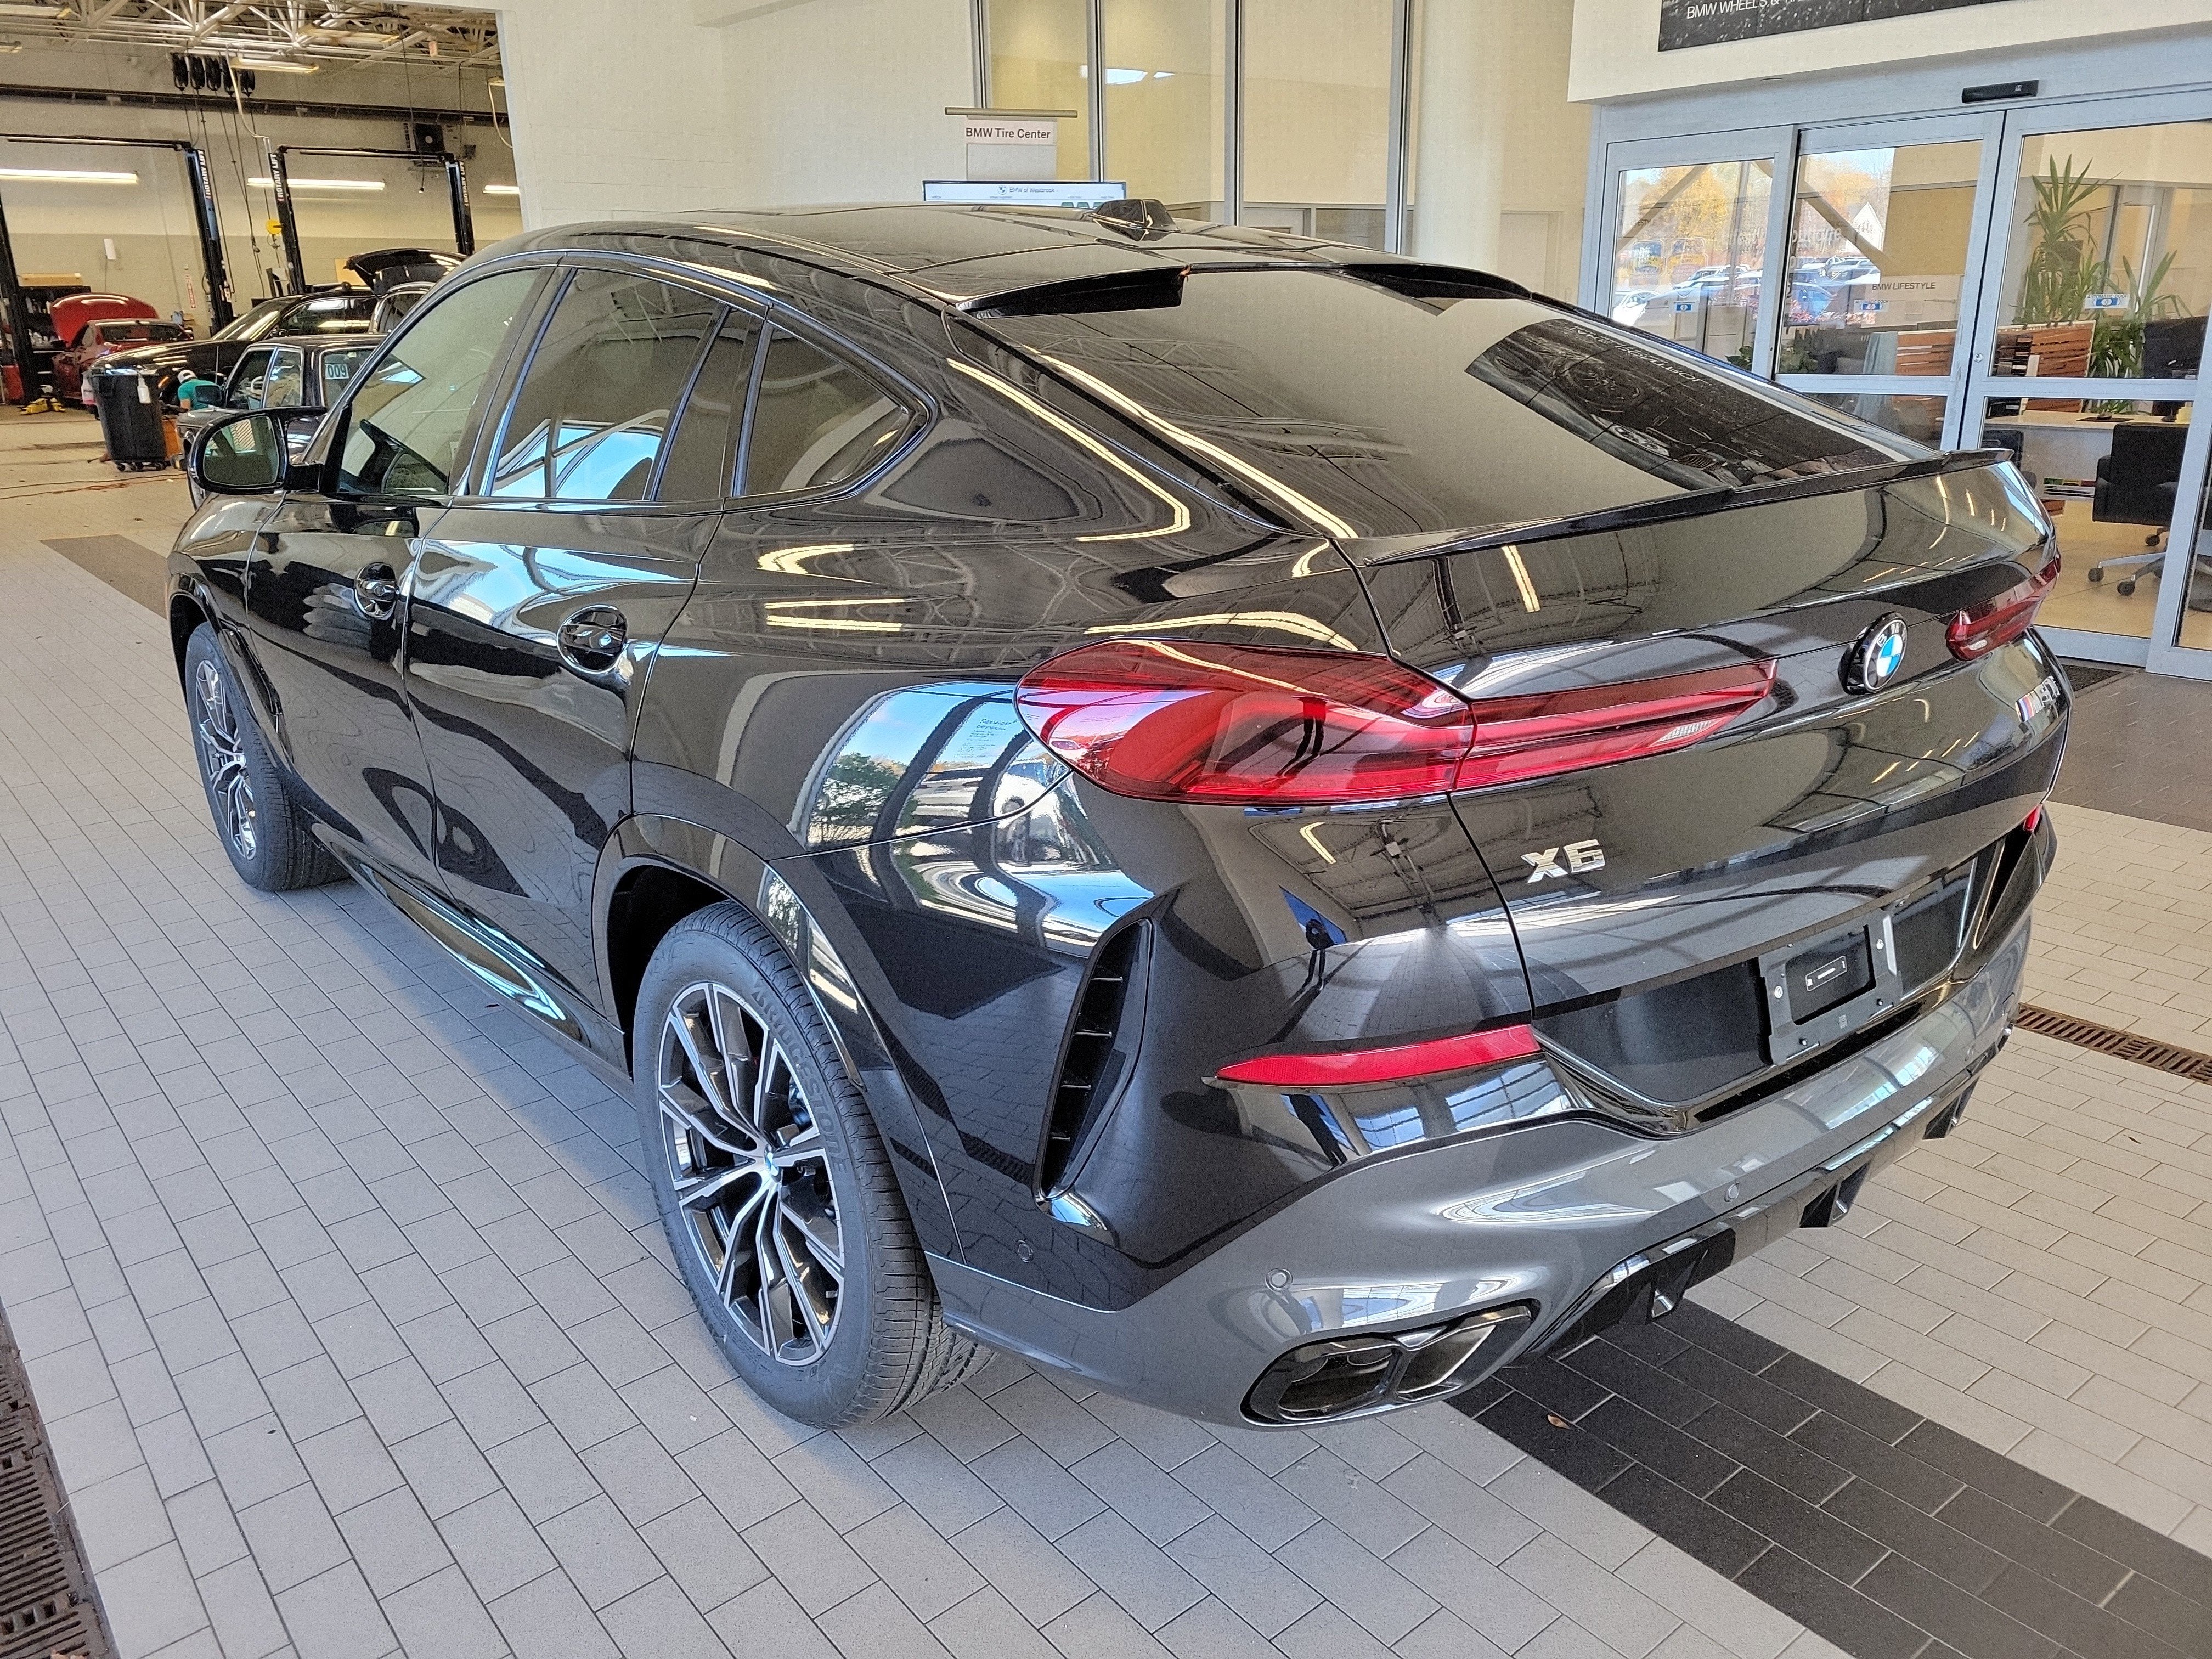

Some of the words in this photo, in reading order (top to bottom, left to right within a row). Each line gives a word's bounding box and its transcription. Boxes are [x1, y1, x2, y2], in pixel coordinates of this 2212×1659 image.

[1686, 2, 1718, 19] BMW
[1719, 0, 1768, 14] WHEELS
[966, 127, 992, 137] BMW
[995, 128, 1014, 138] Tire
[1017, 128, 1051, 139] Center
[198, 150, 206, 165] LIFT
[270, 153, 278, 169] LIFT
[200, 166, 211, 195] ROTARY
[273, 170, 284, 198] ROTARY
[1893, 281, 1936, 290] LIFESTYLE
[328, 364, 347, 378] 009
[1520, 839, 1606, 884] X6
[751, 980, 847, 1174] BRIDGESTONE
